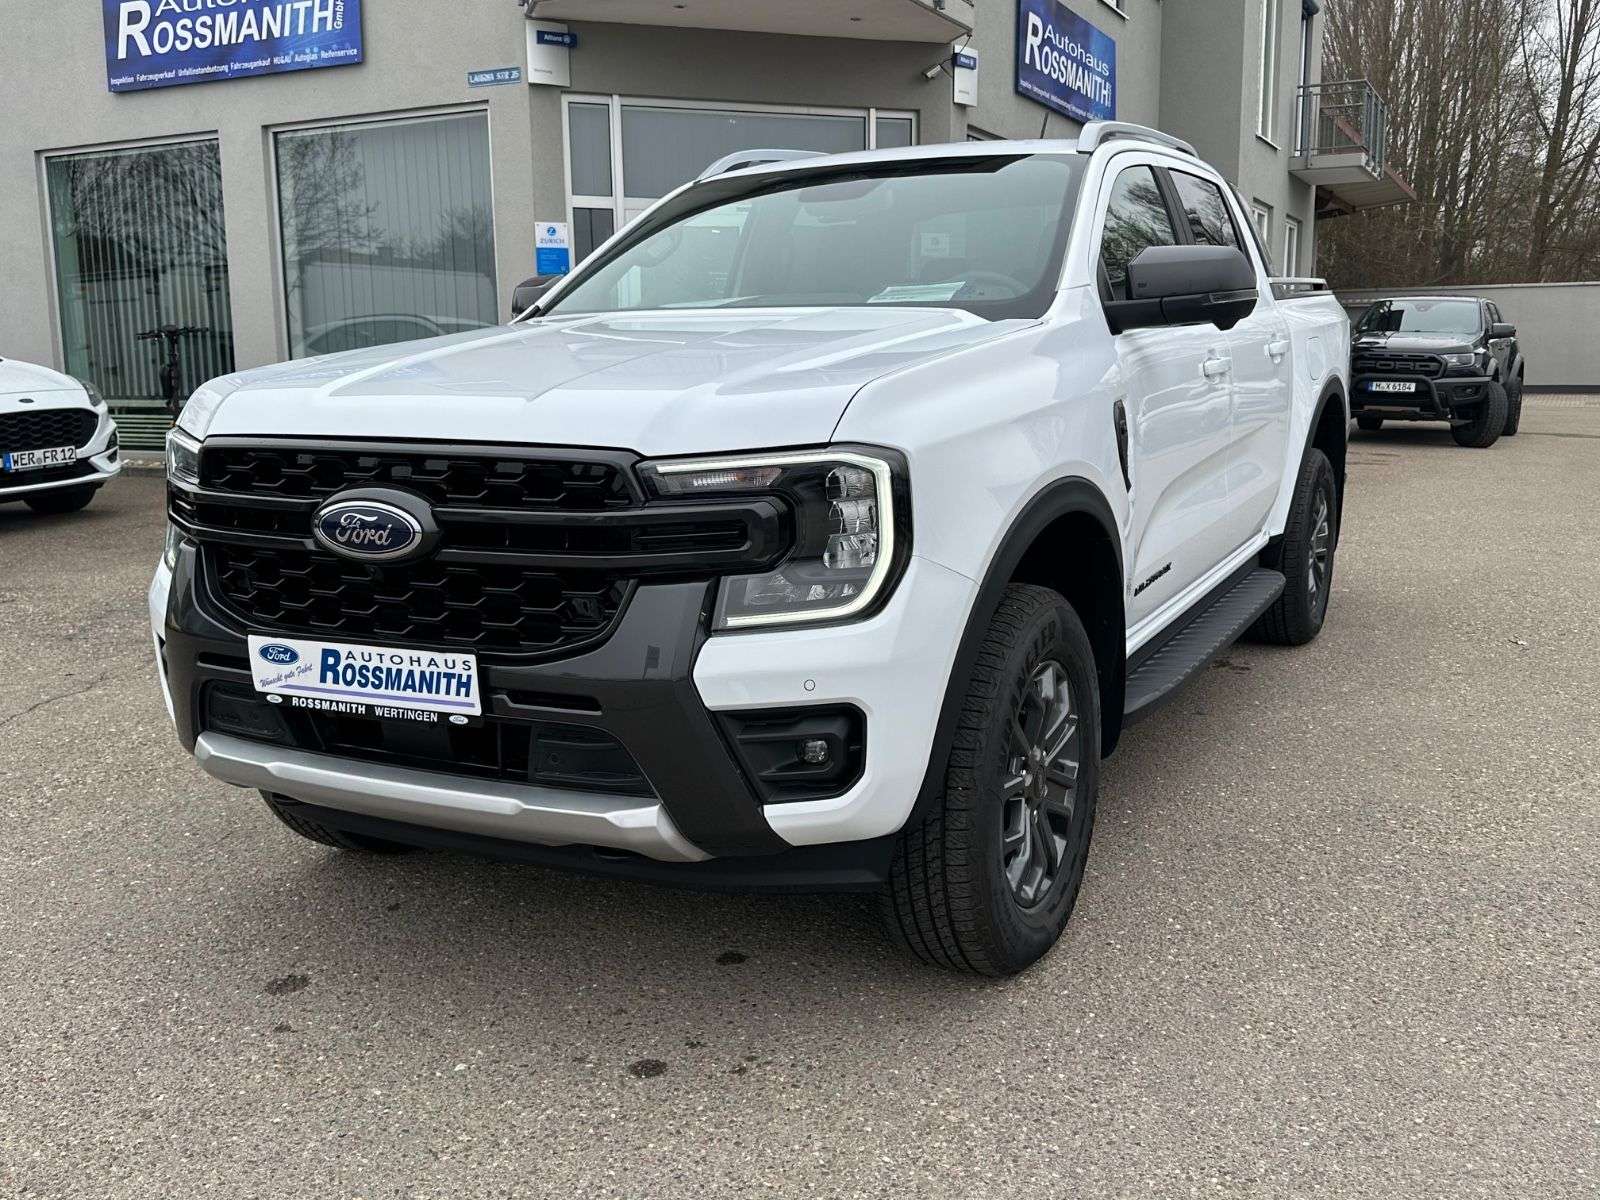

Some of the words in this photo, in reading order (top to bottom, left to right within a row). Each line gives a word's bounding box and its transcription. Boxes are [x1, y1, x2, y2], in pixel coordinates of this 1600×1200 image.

[117, 0, 334, 59] ROSSMANITH
[1024, 11, 1109, 107] ROSSMANITH
[1044, 25, 1109, 76] Autohaus
[12, 452, 36, 467] WER
[335, 512, 393, 546] Ford
[267, 646, 292, 662] Ford
[345, 650, 472, 671] AUTOHAUS
[319, 647, 473, 698] ROSSMANITH
[292, 696, 366, 715] ROSSMANITH
[374, 705, 438, 723] WERTINGEN
